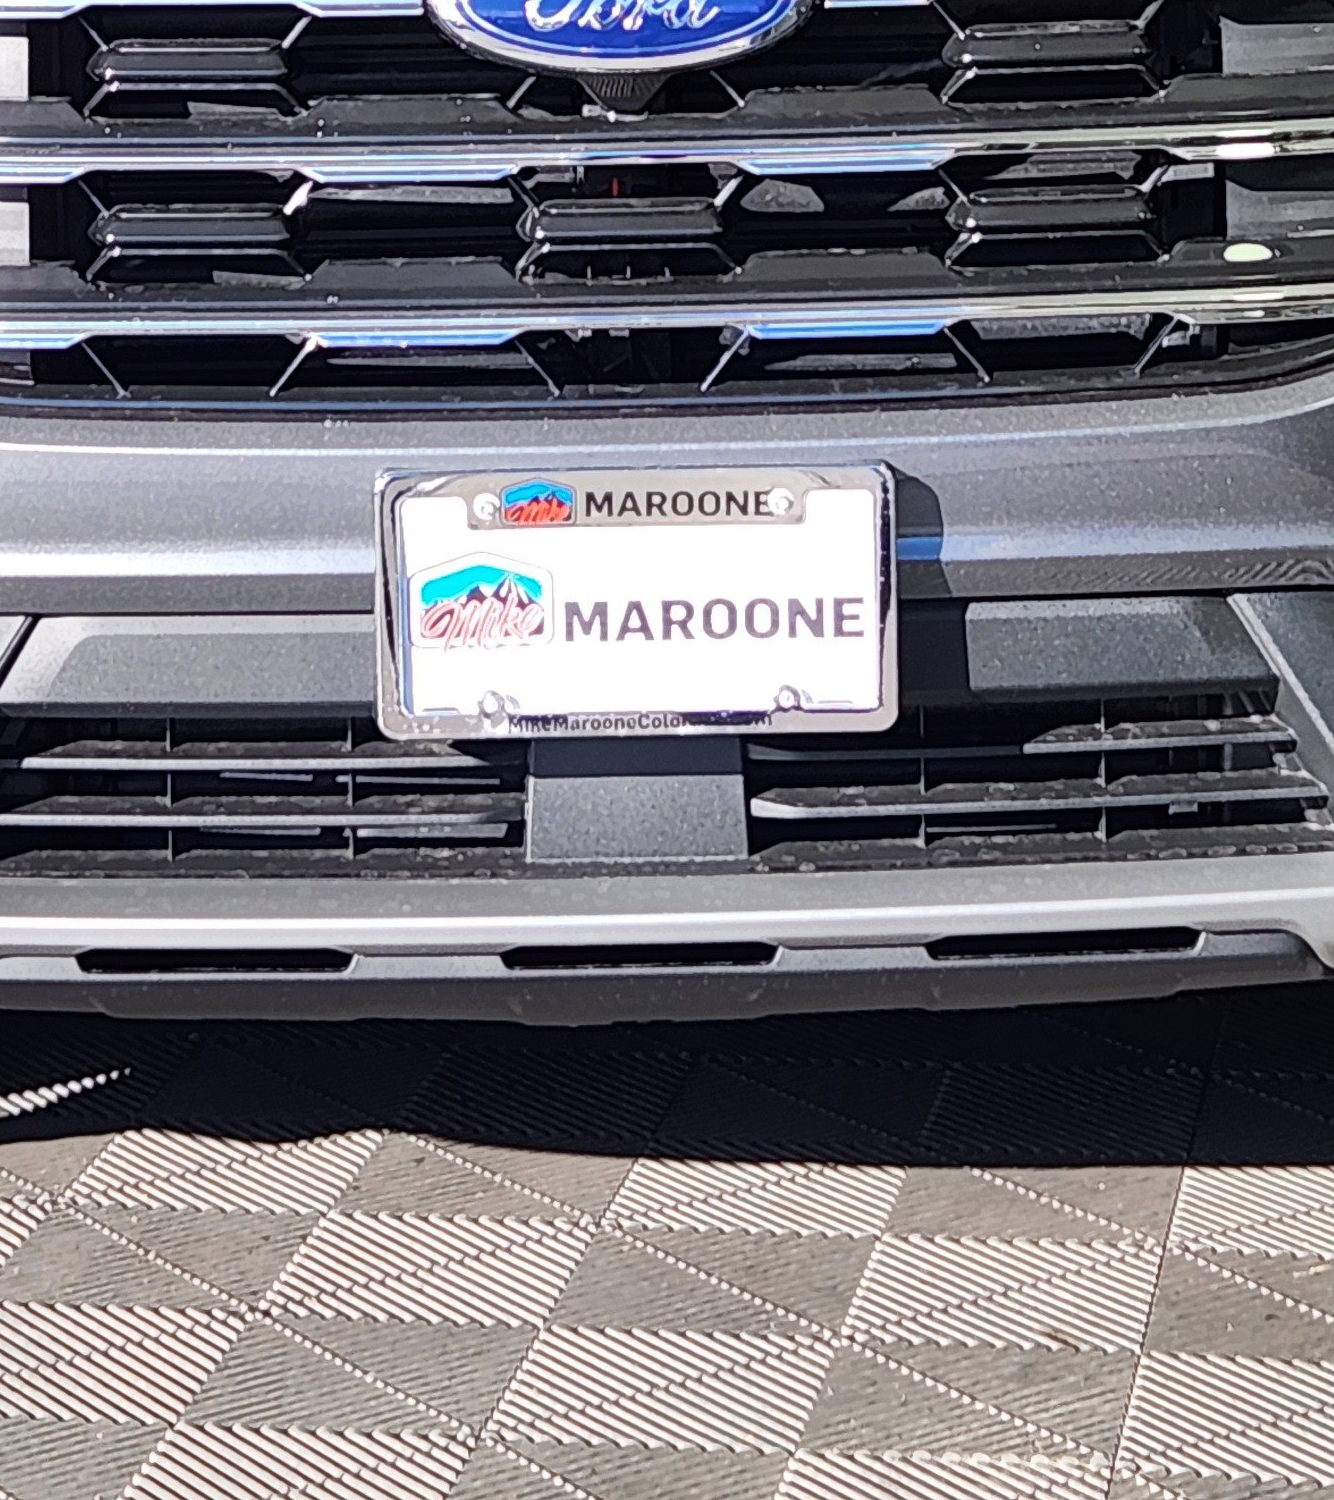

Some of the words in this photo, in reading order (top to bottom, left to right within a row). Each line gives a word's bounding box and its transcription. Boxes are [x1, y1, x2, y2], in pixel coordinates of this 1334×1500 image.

[585, 490, 773, 517] MAROONE
[421, 594, 546, 652] Mike
[565, 597, 865, 642] MAROONE
